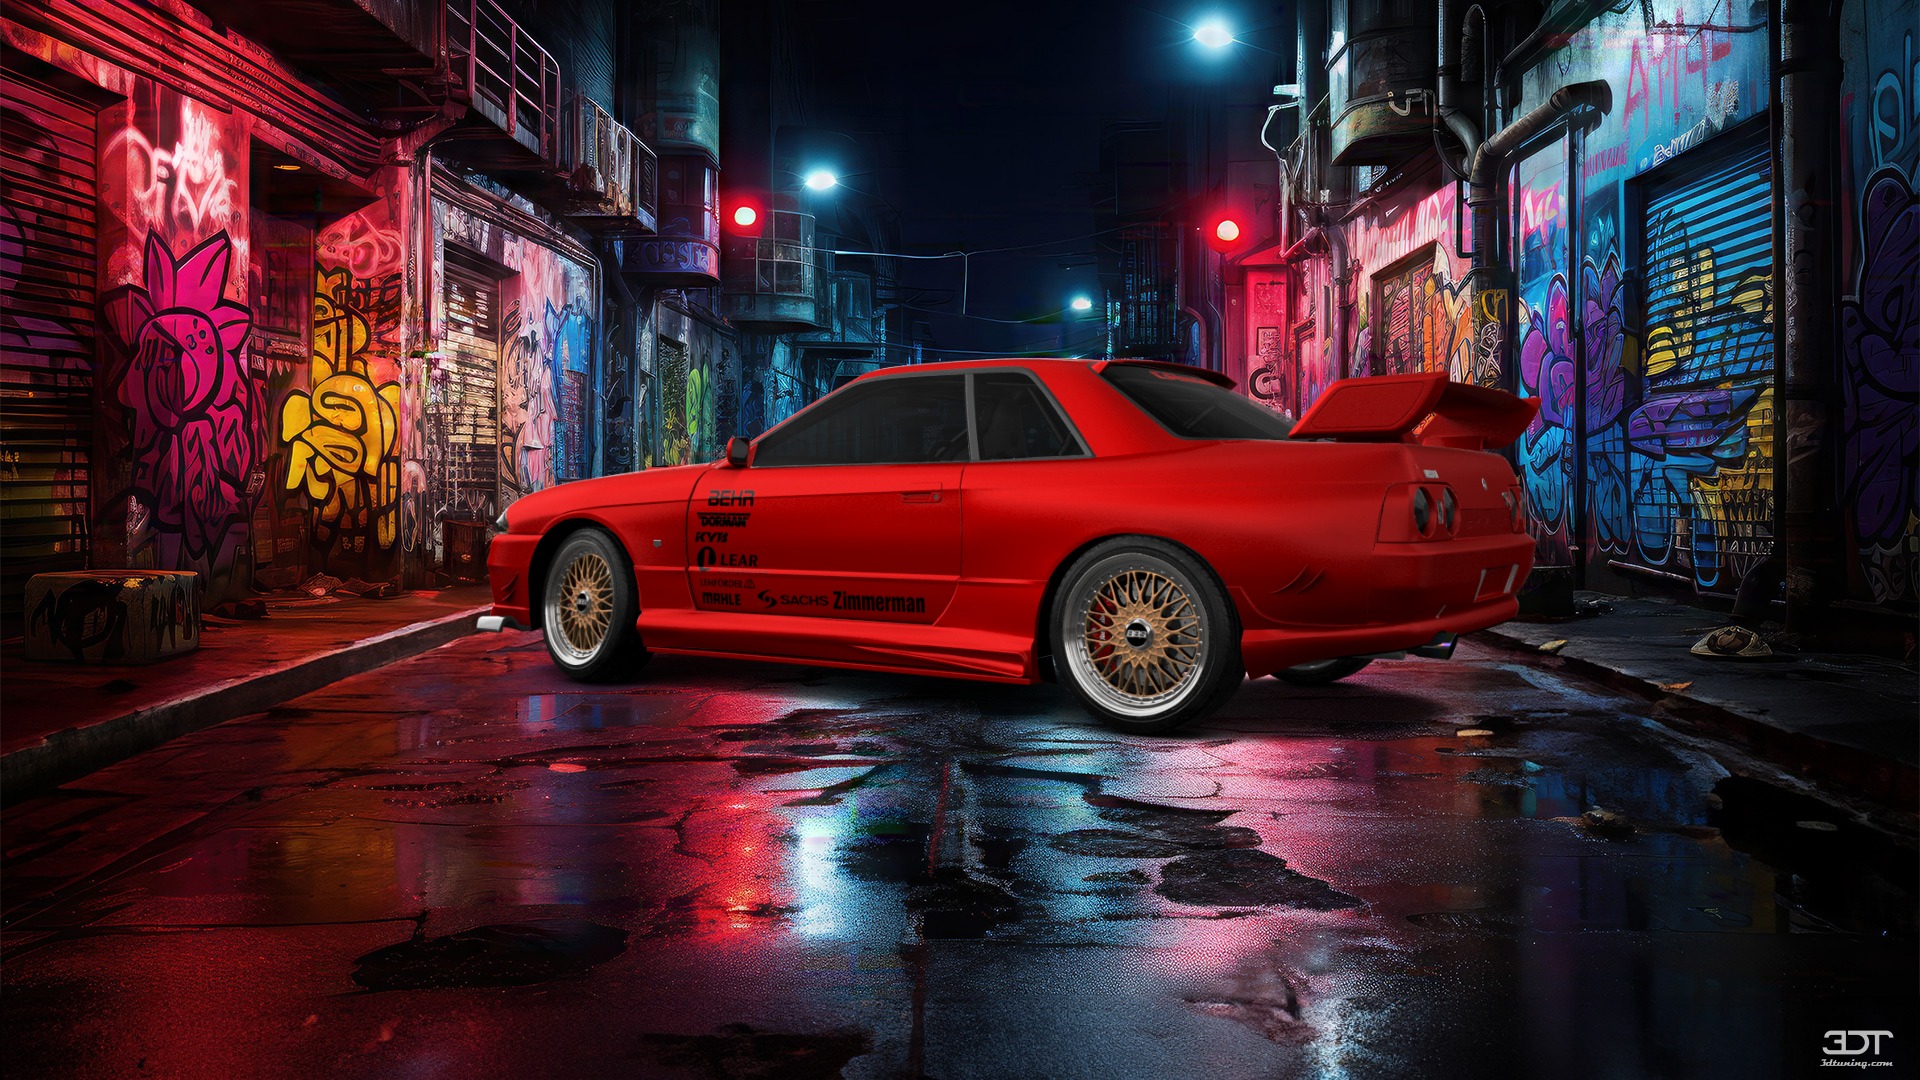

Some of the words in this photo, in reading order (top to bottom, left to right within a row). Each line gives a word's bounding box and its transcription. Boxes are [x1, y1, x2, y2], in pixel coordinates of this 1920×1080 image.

[708, 490, 755, 507] BEHR
[700, 514, 748, 527] DORMAN
[695, 532, 728, 543] KYB
[721, 554, 758, 567] LEAR
[702, 592, 742, 606] MAHLE
[780, 595, 829, 606] SACHS
[833, 591, 926, 613] Zimmerman
